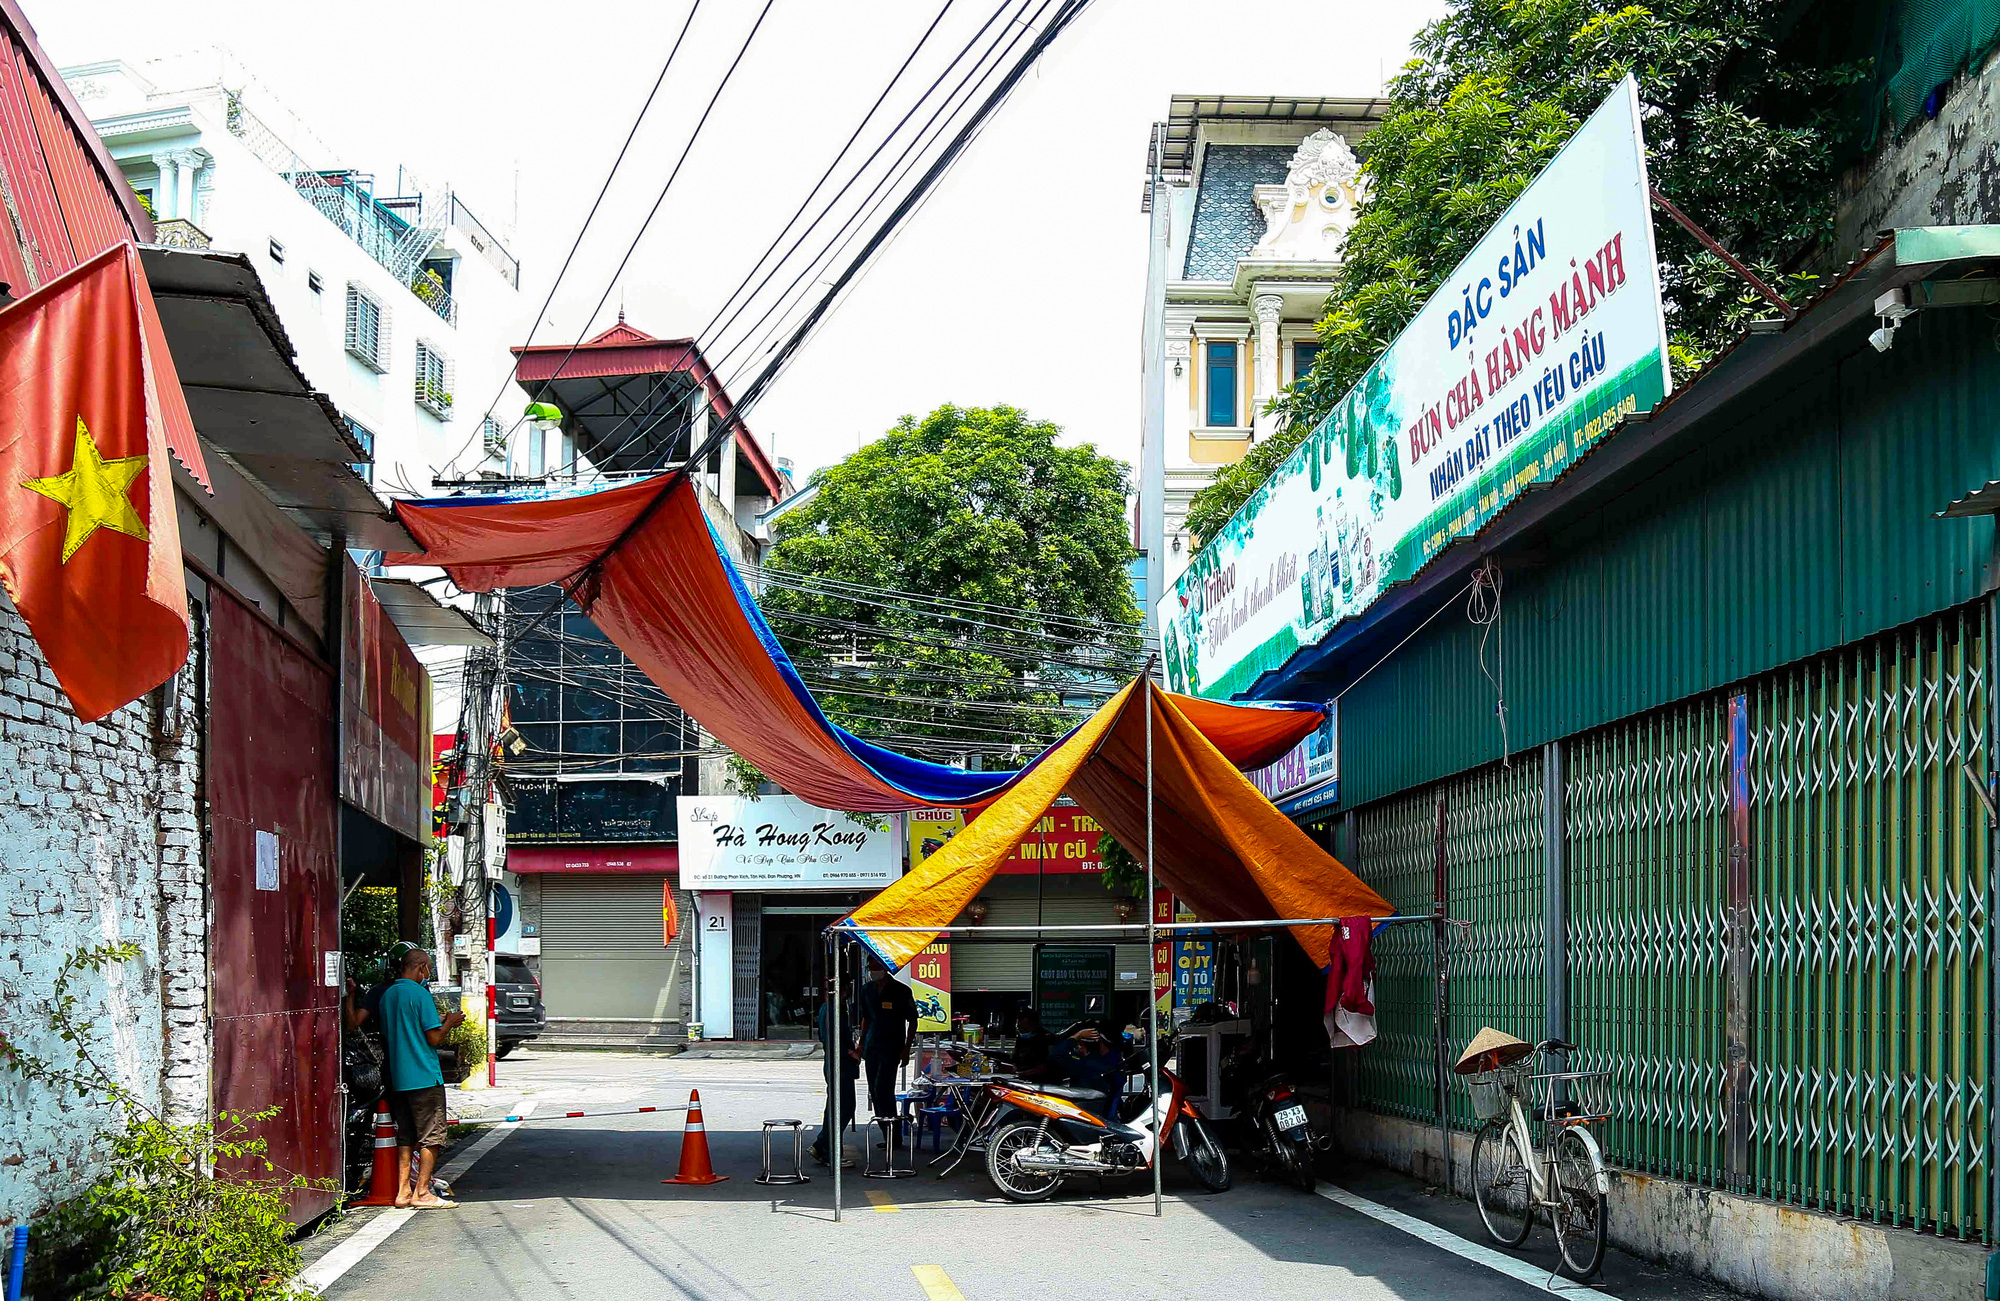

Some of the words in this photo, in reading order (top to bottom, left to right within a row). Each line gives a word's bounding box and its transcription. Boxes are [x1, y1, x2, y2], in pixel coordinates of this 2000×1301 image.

[1448, 277, 1492, 351] ĐẶC
[1499, 217, 1546, 298] SẢN
[1408, 402, 1443, 465] BÚN
[1446, 350, 1484, 430] CHẢ
[1485, 306, 1546, 396] HÀNG
[1429, 447, 1464, 501] NHẬN
[1465, 424, 1491, 470] ĐẶT
[1493, 393, 1531, 448] THEO
[1533, 363, 1565, 417] YÊU
[1569, 329, 1606, 391] CẦU
[1204, 562, 1236, 613] Tribeco
[690, 807, 719, 826] Shop
[1072, 815, 1104, 832] TRA
[713, 823, 748, 848] Hà
[1064, 839, 1087, 859] CŨ
[1082, 861, 1096, 870] ĐT:
[1158, 903, 1168, 917] XE
[709, 916, 725, 928] 21
[1157, 947, 1168, 964] CŨ
[918, 957, 941, 979] ĐỔI
